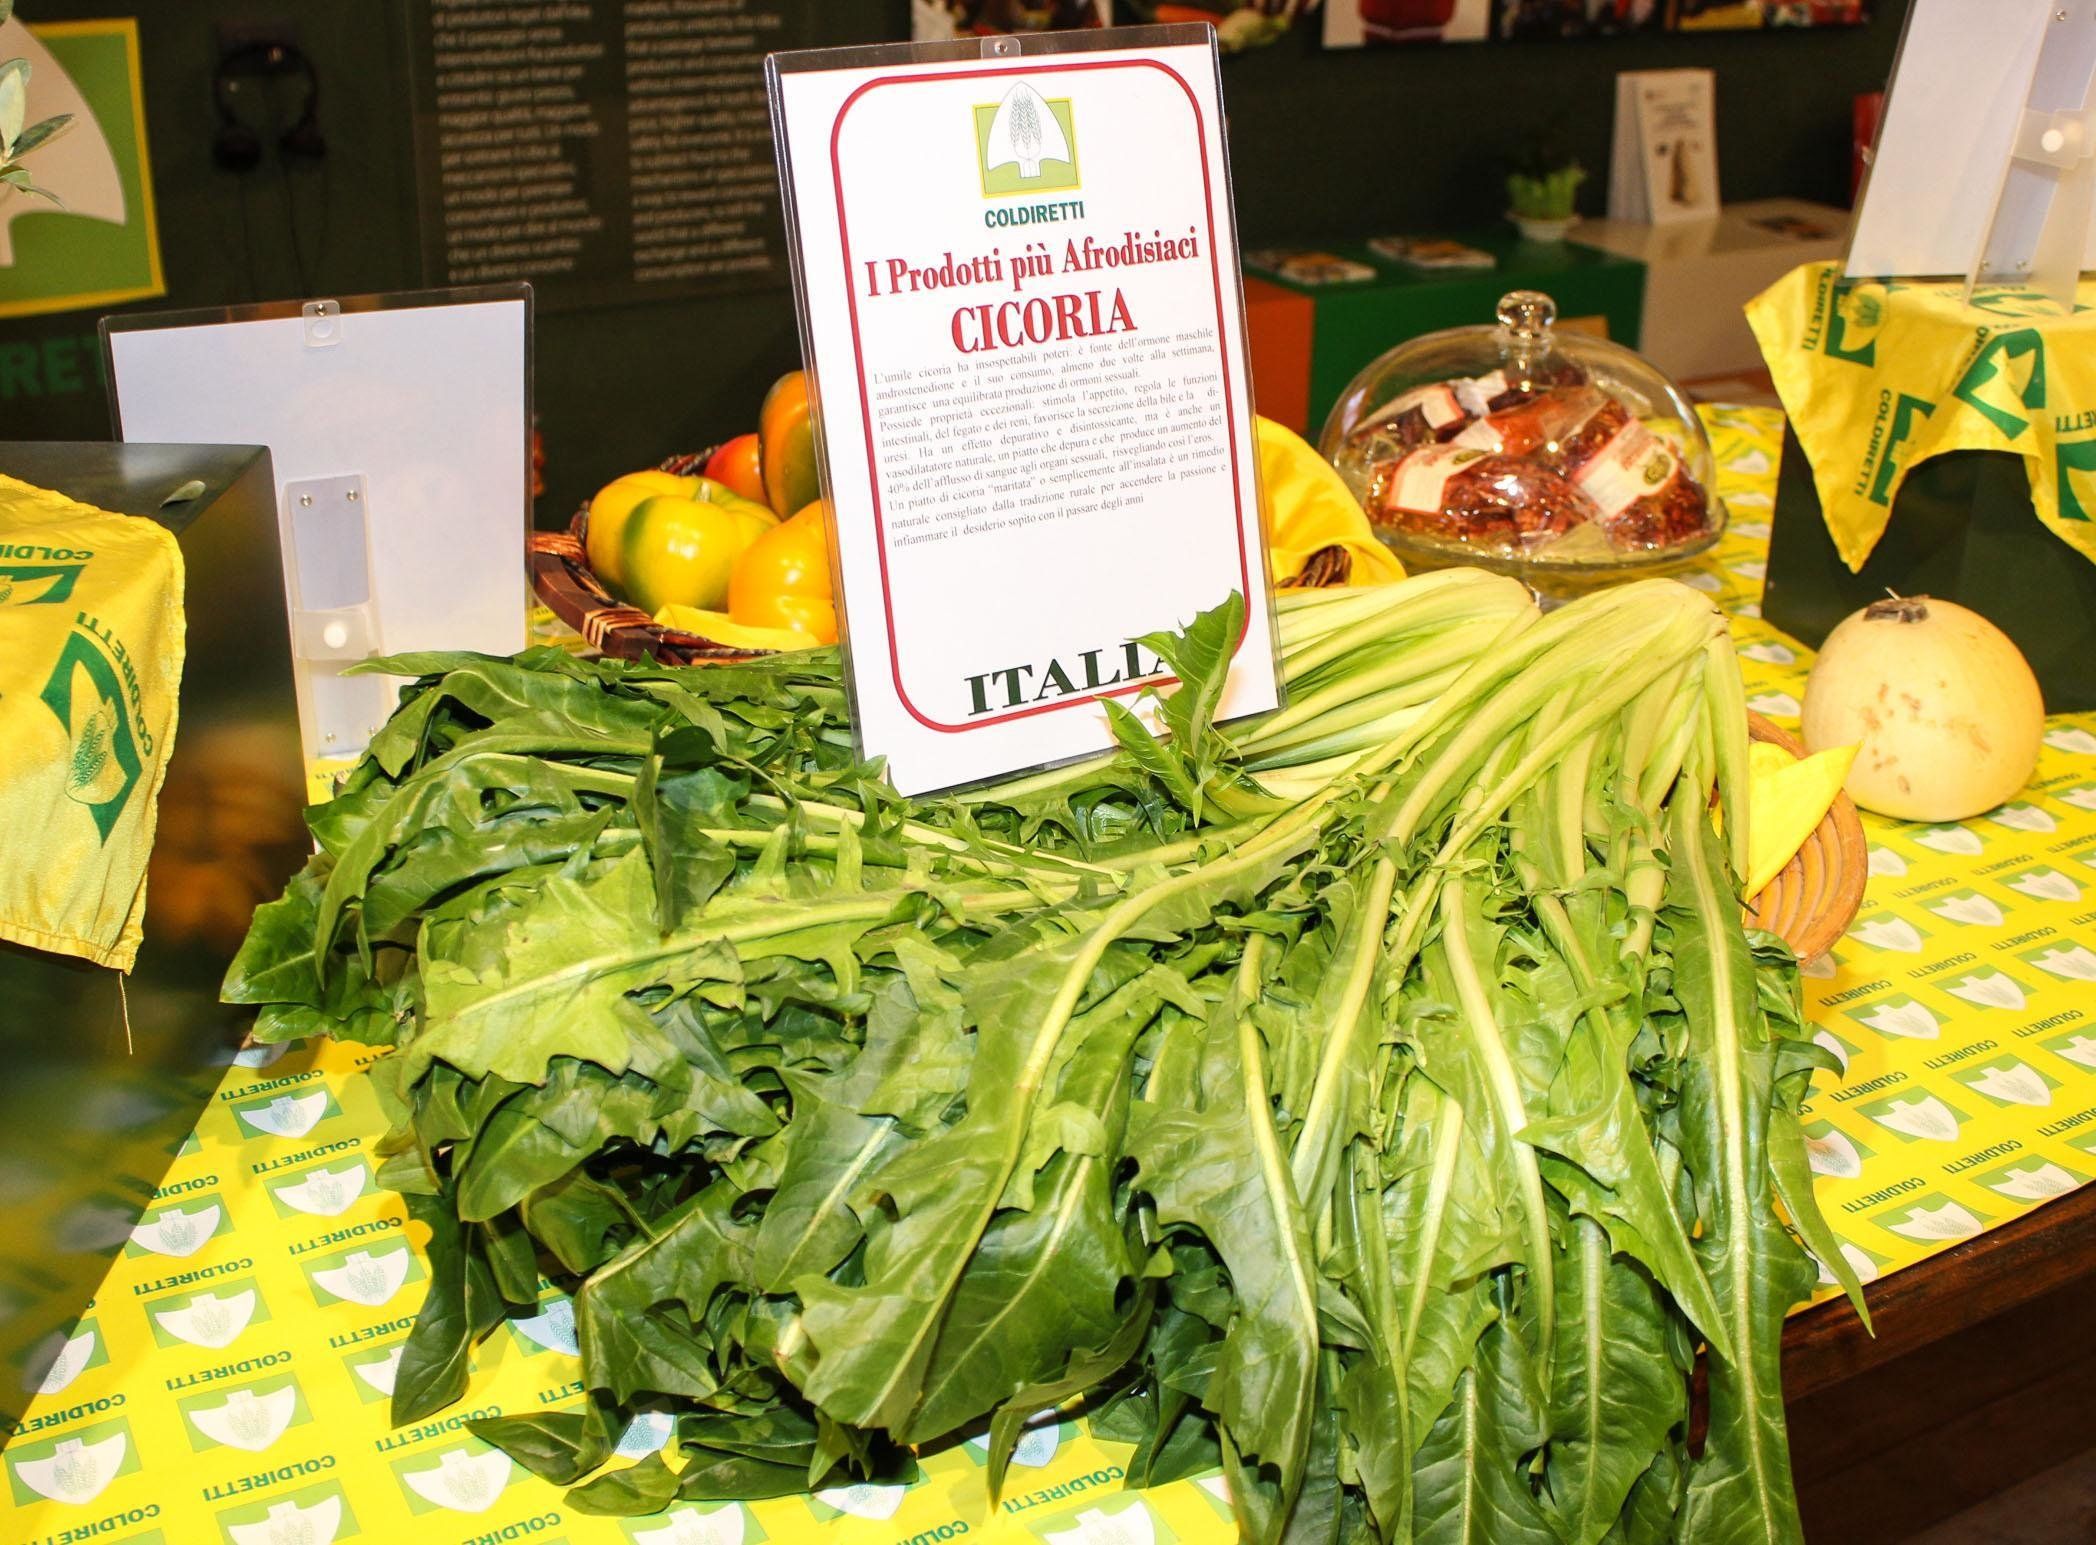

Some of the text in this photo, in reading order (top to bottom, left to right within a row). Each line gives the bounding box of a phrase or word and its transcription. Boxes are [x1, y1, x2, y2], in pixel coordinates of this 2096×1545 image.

[984, 201, 1084, 228] COLDIRETTI
[865, 226, 1198, 296] I Prodotti più Afrodisiaci
[952, 287, 1138, 354] CICORIA
[1908, 952, 1977, 978] COLDIRETTI
[1818, 980, 1892, 1006] COLDIRETTI
[2012, 1010, 2084, 1038] COLDIRETTI
[1922, 1040, 1998, 1070] COLDIRETTI
[220, 1070, 324, 1101] COLDIRETTI
[1829, 1071, 1908, 1102] COLDIRETTI
[252, 1138, 361, 1174] COLDIRETTI
[1942, 1140, 2023, 1173] COLDIRETTI
[1841, 1177, 1927, 1212] COLDIRETTI
[289, 1217, 402, 1256] COLDIRETTI
[134, 1258, 253, 1296] COLDIRETTI
[329, 1314, 419, 1348] DIRETTI
[166, 1350, 292, 1391] COLDIRETTI
[12, 1394, 126, 1436] COLDIRET
[202, 1455, 336, 1502] COLDIRETTI
[1002, 1466, 1124, 1514] COLDIRETTI
